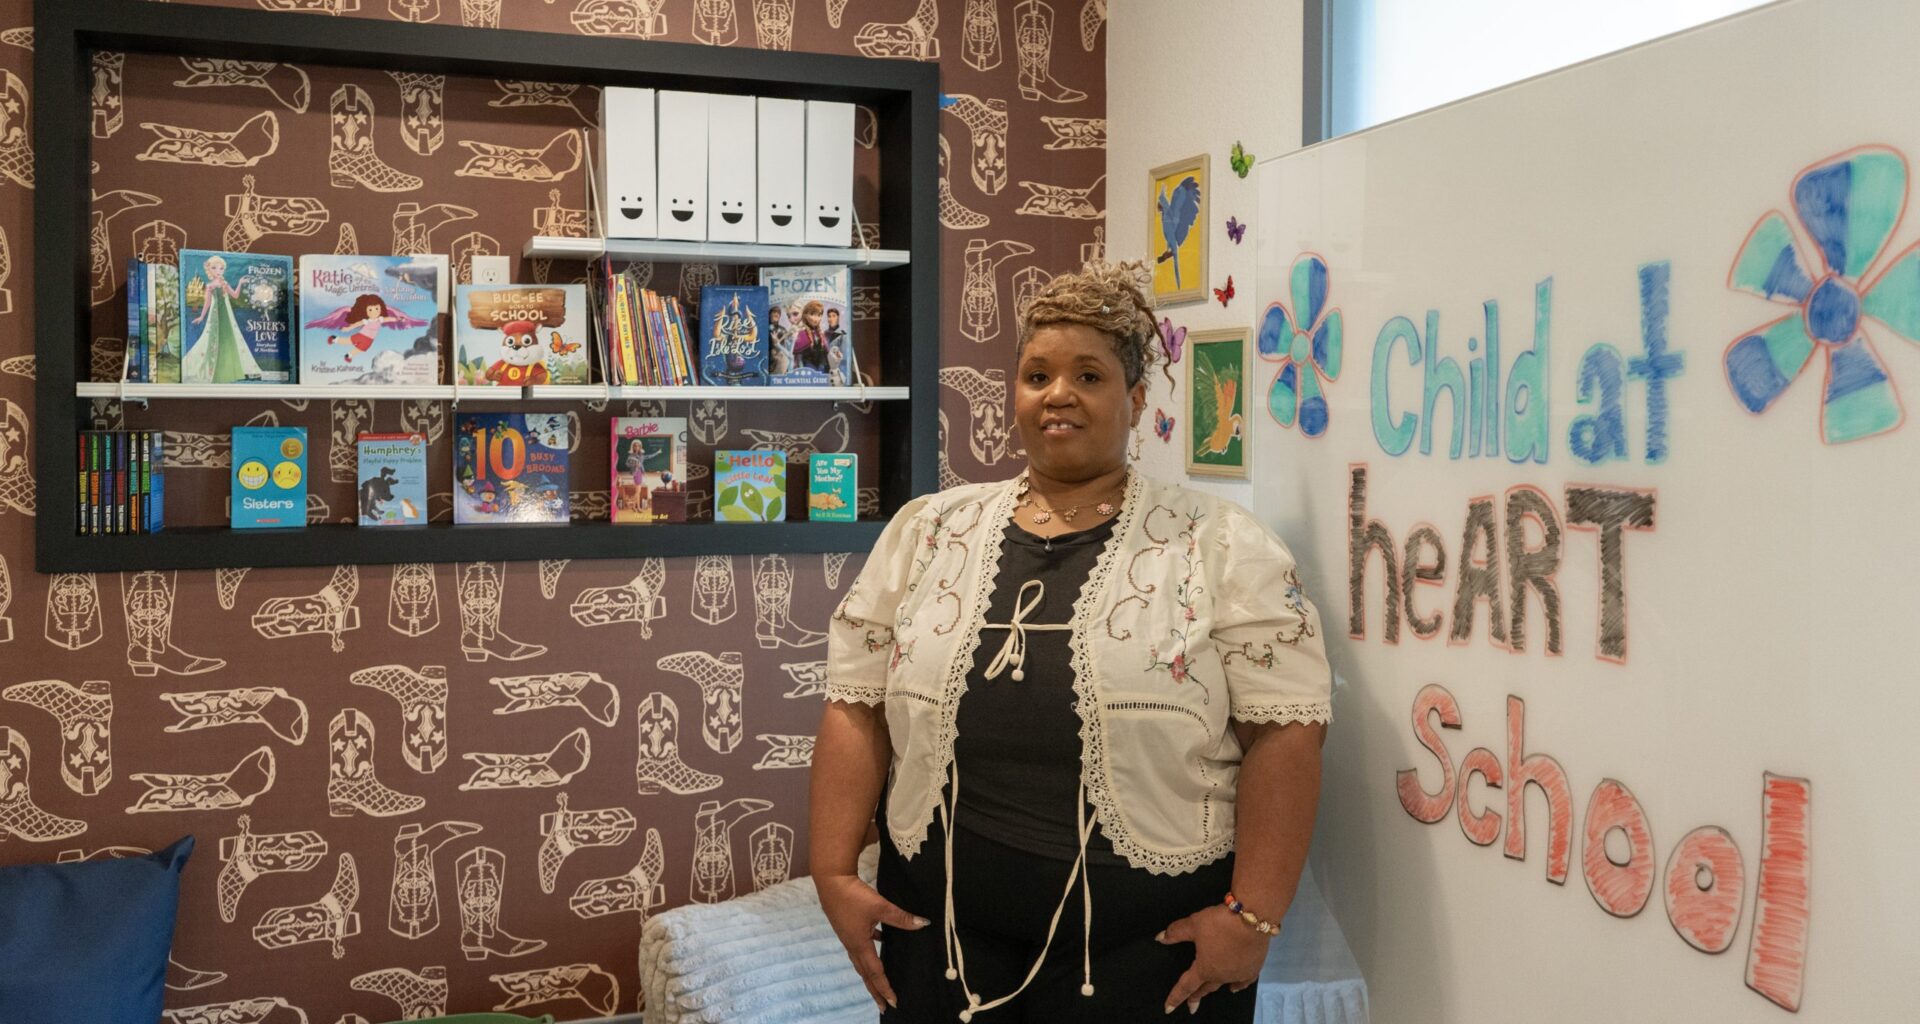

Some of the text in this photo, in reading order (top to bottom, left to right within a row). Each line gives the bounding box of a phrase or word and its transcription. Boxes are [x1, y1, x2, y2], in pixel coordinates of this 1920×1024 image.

[248, 265, 282, 275] FROZEN
[312, 269, 353, 288] Katie
[324, 283, 349, 296] Magic
[770, 277, 837, 296] FROZEN
[493, 293, 544, 304] BUC-EE
[490, 310, 548, 321] SCHOOL
[246, 319, 286, 331] SISTER'S
[255, 331, 278, 342] LOVE
[1370, 260, 1686, 465] Child at
[624, 422, 659, 440] Barbie
[363, 443, 422, 457] Humphrey's
[473, 427, 526, 480] 10
[530, 452, 556, 462] BUSY
[728, 453, 775, 467] Hello
[526, 463, 566, 474] BROOMS
[816, 466, 842, 476] You My
[814, 474, 844, 483] Mother?
[242, 497, 295, 510] Sisters
[1347, 462, 1658, 665] heART
[1395, 683, 1812, 1013] School
